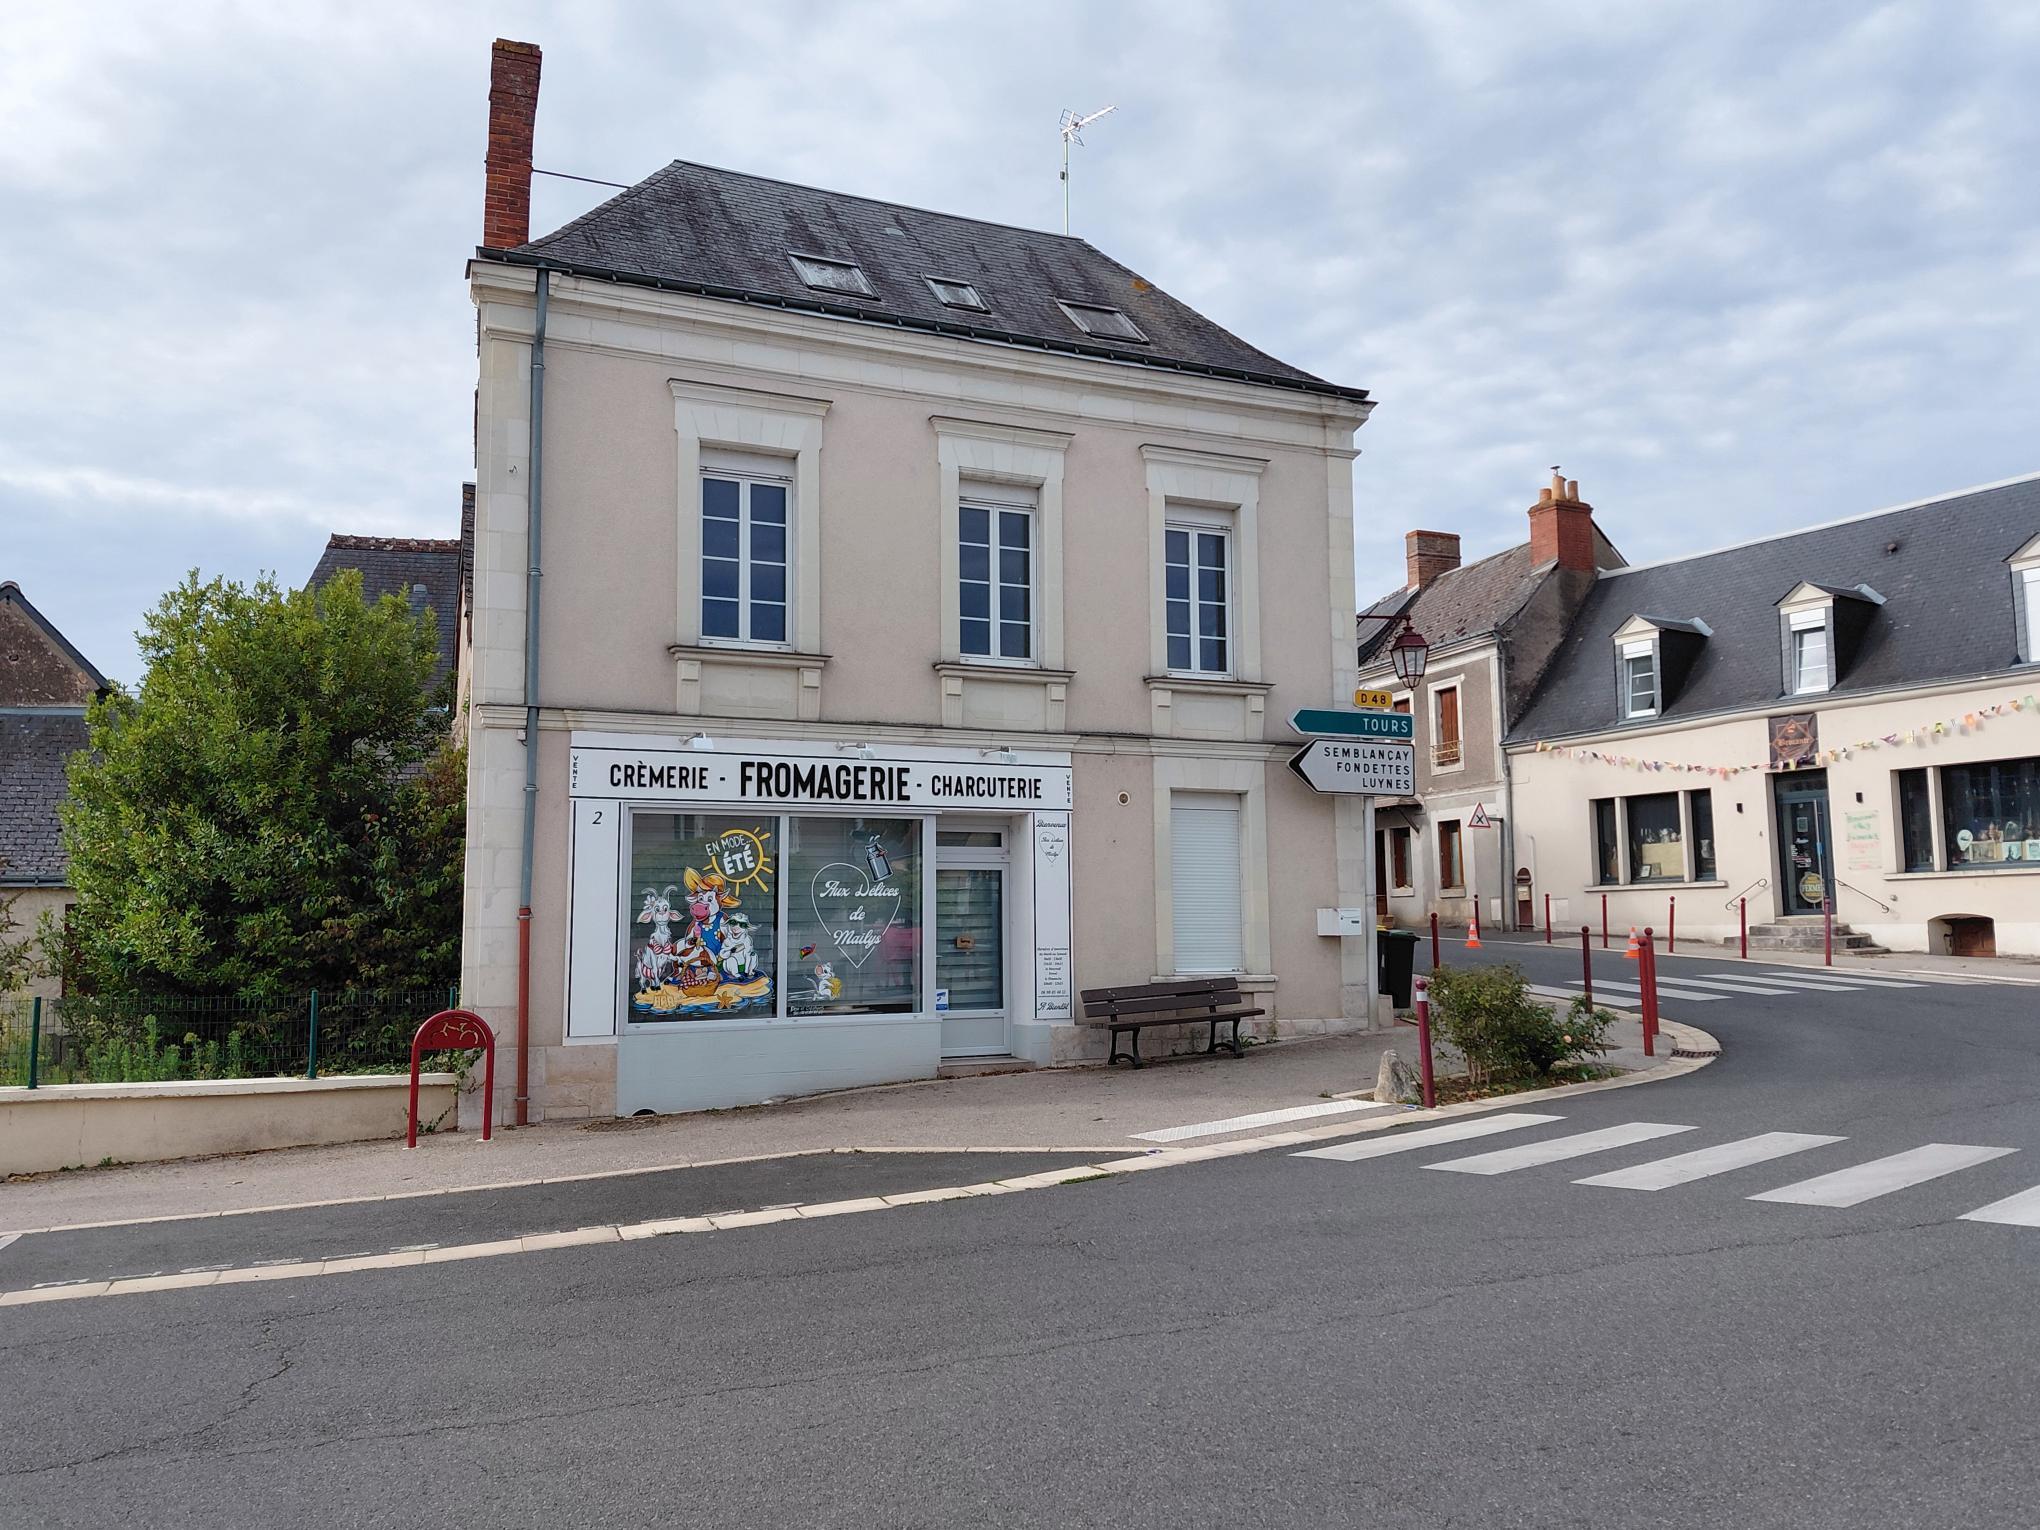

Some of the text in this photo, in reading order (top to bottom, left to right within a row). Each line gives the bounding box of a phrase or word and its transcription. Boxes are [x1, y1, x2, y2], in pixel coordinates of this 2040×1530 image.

[1361, 693, 1386, 704] D 48
[1363, 718, 1408, 732] TOURS
[1324, 747, 1409, 760] SEMBLANÇAY
[1337, 762, 1410, 775] FONDETTES
[610, 761, 709, 789] CRÈMERIE
[740, 761, 911, 801] FROMAGERIE
[931, 775, 1042, 799] CHARCUTERIE
[1363, 778, 1410, 790] LUYNES
[592, 811, 603, 825] 2
[705, 840, 720, 856] EN
[723, 844, 755, 875] ÉTÉ
[820, 880, 900, 897] Aux Délices
[849, 905, 866, 921] de
